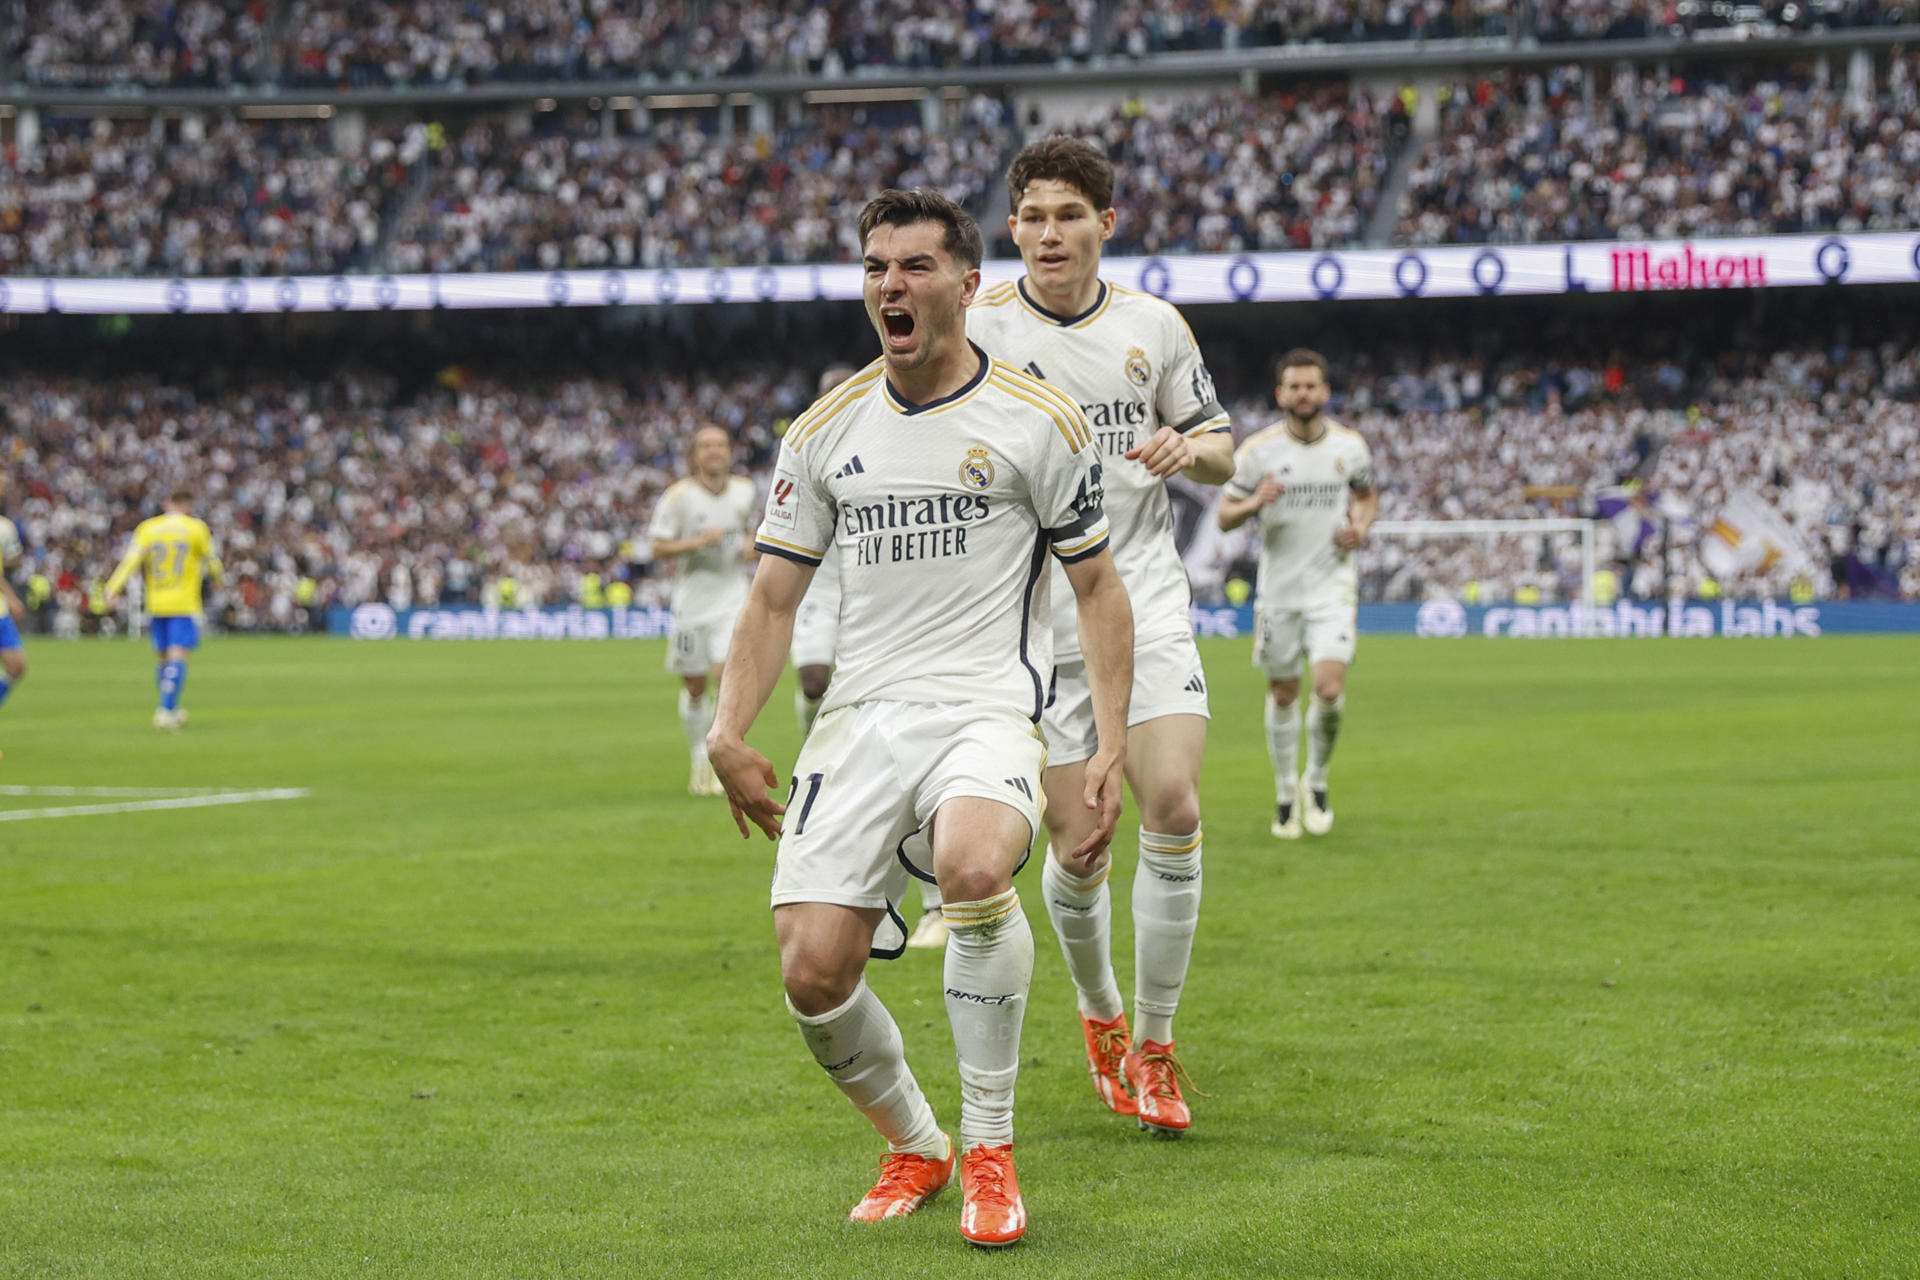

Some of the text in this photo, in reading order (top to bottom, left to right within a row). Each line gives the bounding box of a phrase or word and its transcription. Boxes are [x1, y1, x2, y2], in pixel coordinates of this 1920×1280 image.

[1610, 243, 1769, 293] Mahou
[1081, 397, 1147, 427] rates
[1097, 430, 1135, 456] TTER
[842, 493, 990, 536] Emirates
[857, 527, 967, 567] FLY BETTER
[946, 988, 1016, 1006] RMCF
